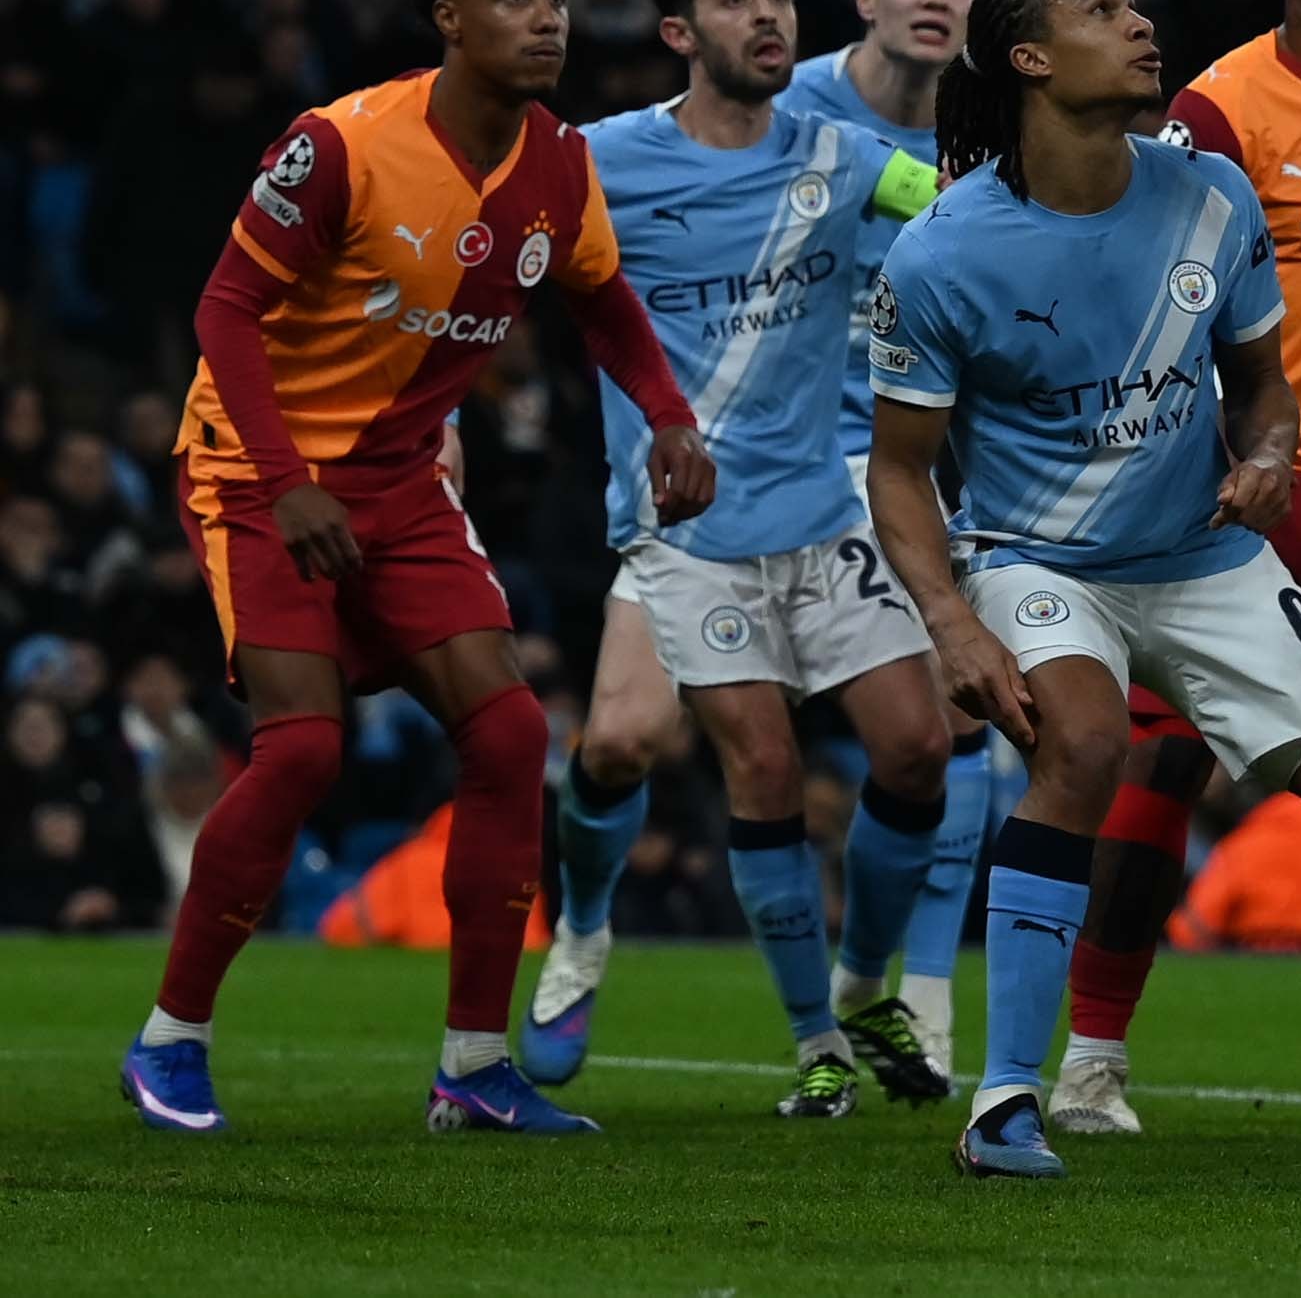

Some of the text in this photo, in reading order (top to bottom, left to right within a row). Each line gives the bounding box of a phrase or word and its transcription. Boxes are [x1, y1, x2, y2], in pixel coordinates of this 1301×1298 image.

[646, 249, 836, 313] ETIHAD
[397, 306, 513, 344] SOCAR
[702, 299, 808, 342] AIRWAYS
[1020, 354, 1204, 419] ETIHA
[1072, 403, 1194, 448] AIRWAYS
[838, 538, 891, 599] 2
